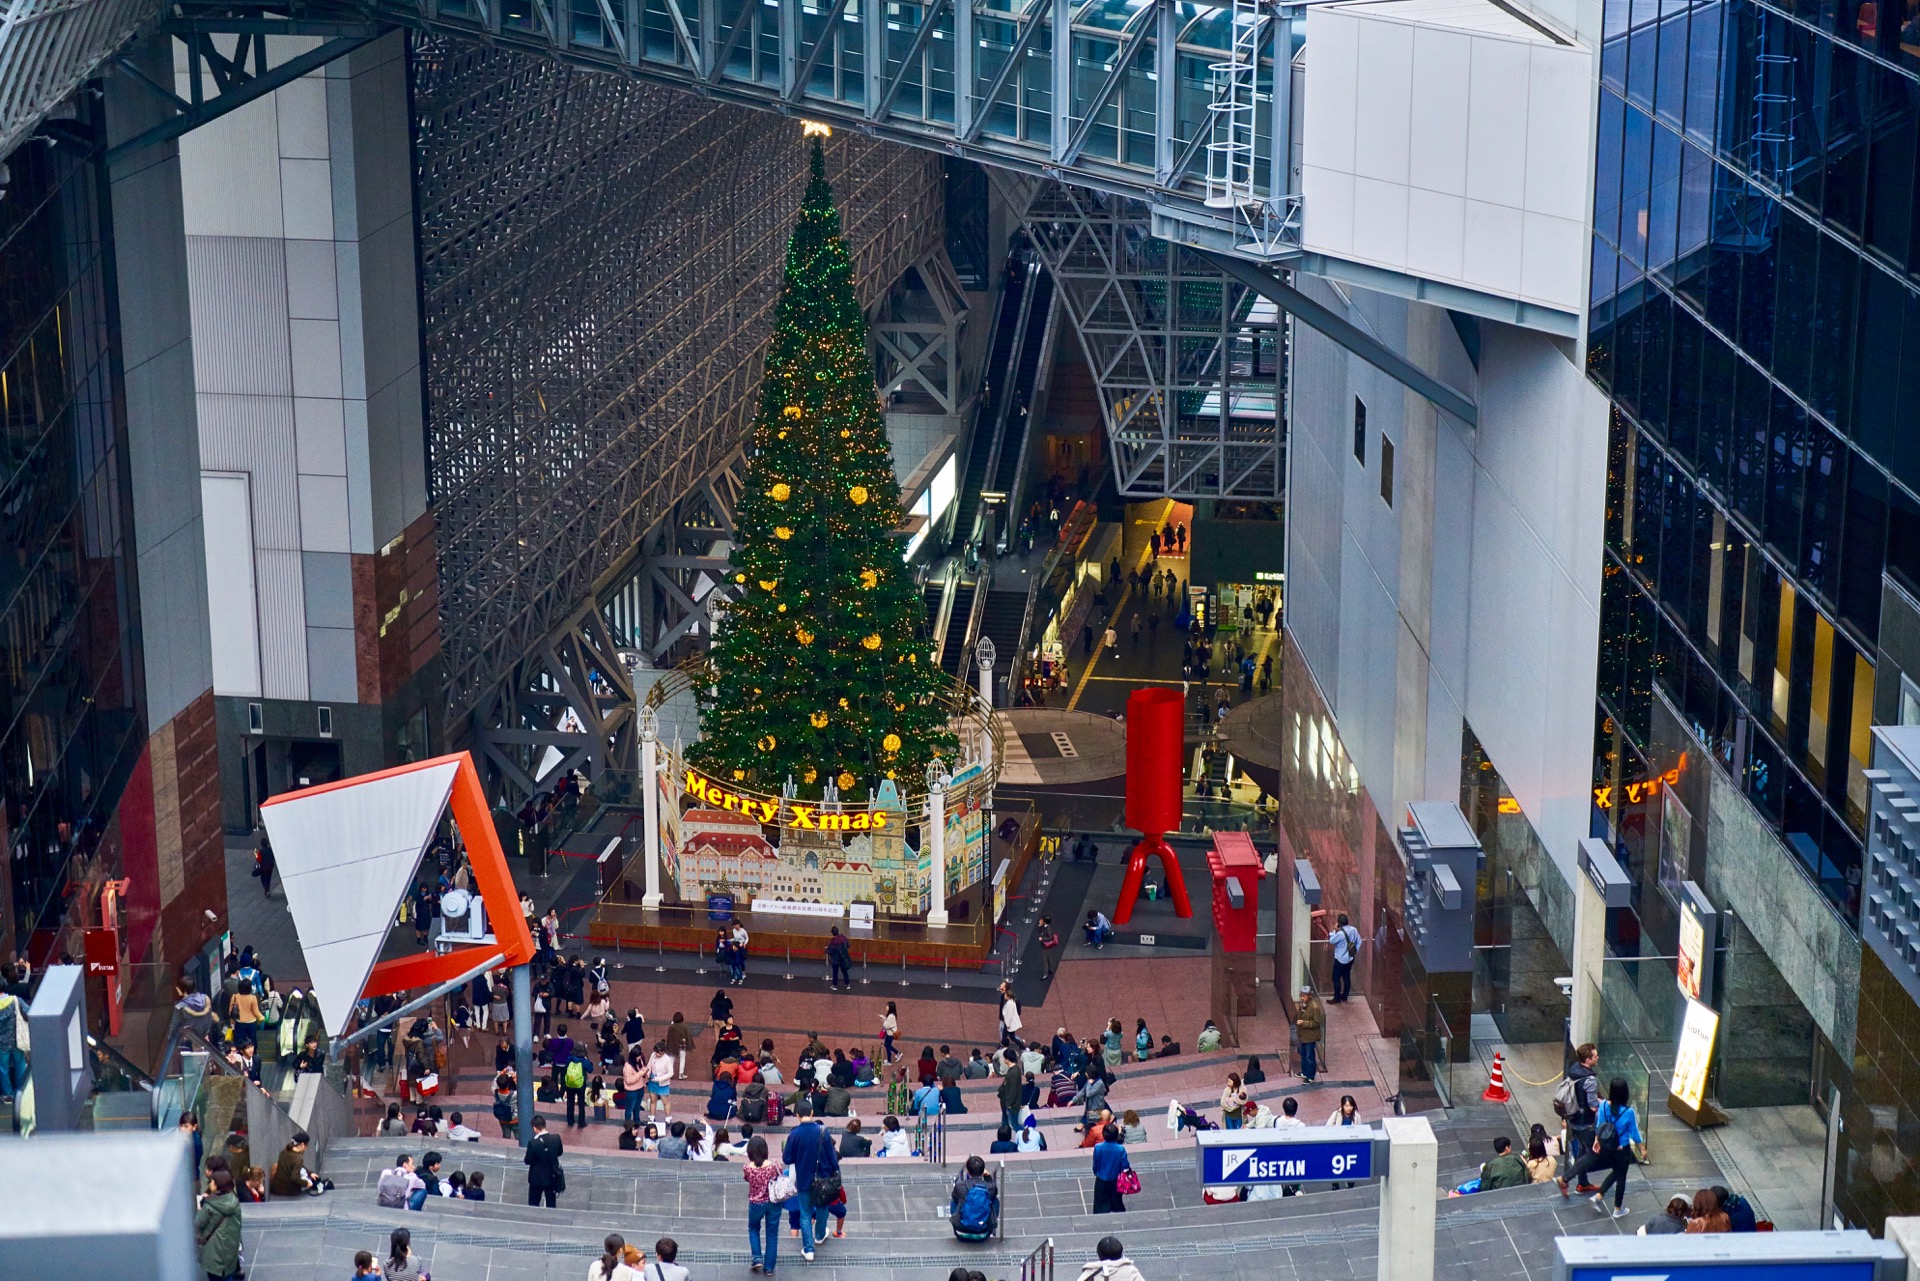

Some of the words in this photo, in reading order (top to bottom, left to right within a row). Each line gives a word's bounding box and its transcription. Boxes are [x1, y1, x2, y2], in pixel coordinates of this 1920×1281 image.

[685, 770, 780, 823] Merry
[788, 805, 887, 830] Xmas
[1226, 1154, 1239, 1167] JR
[1248, 1157, 1306, 1178] ISETAN
[1331, 1154, 1358, 1175] 9F
